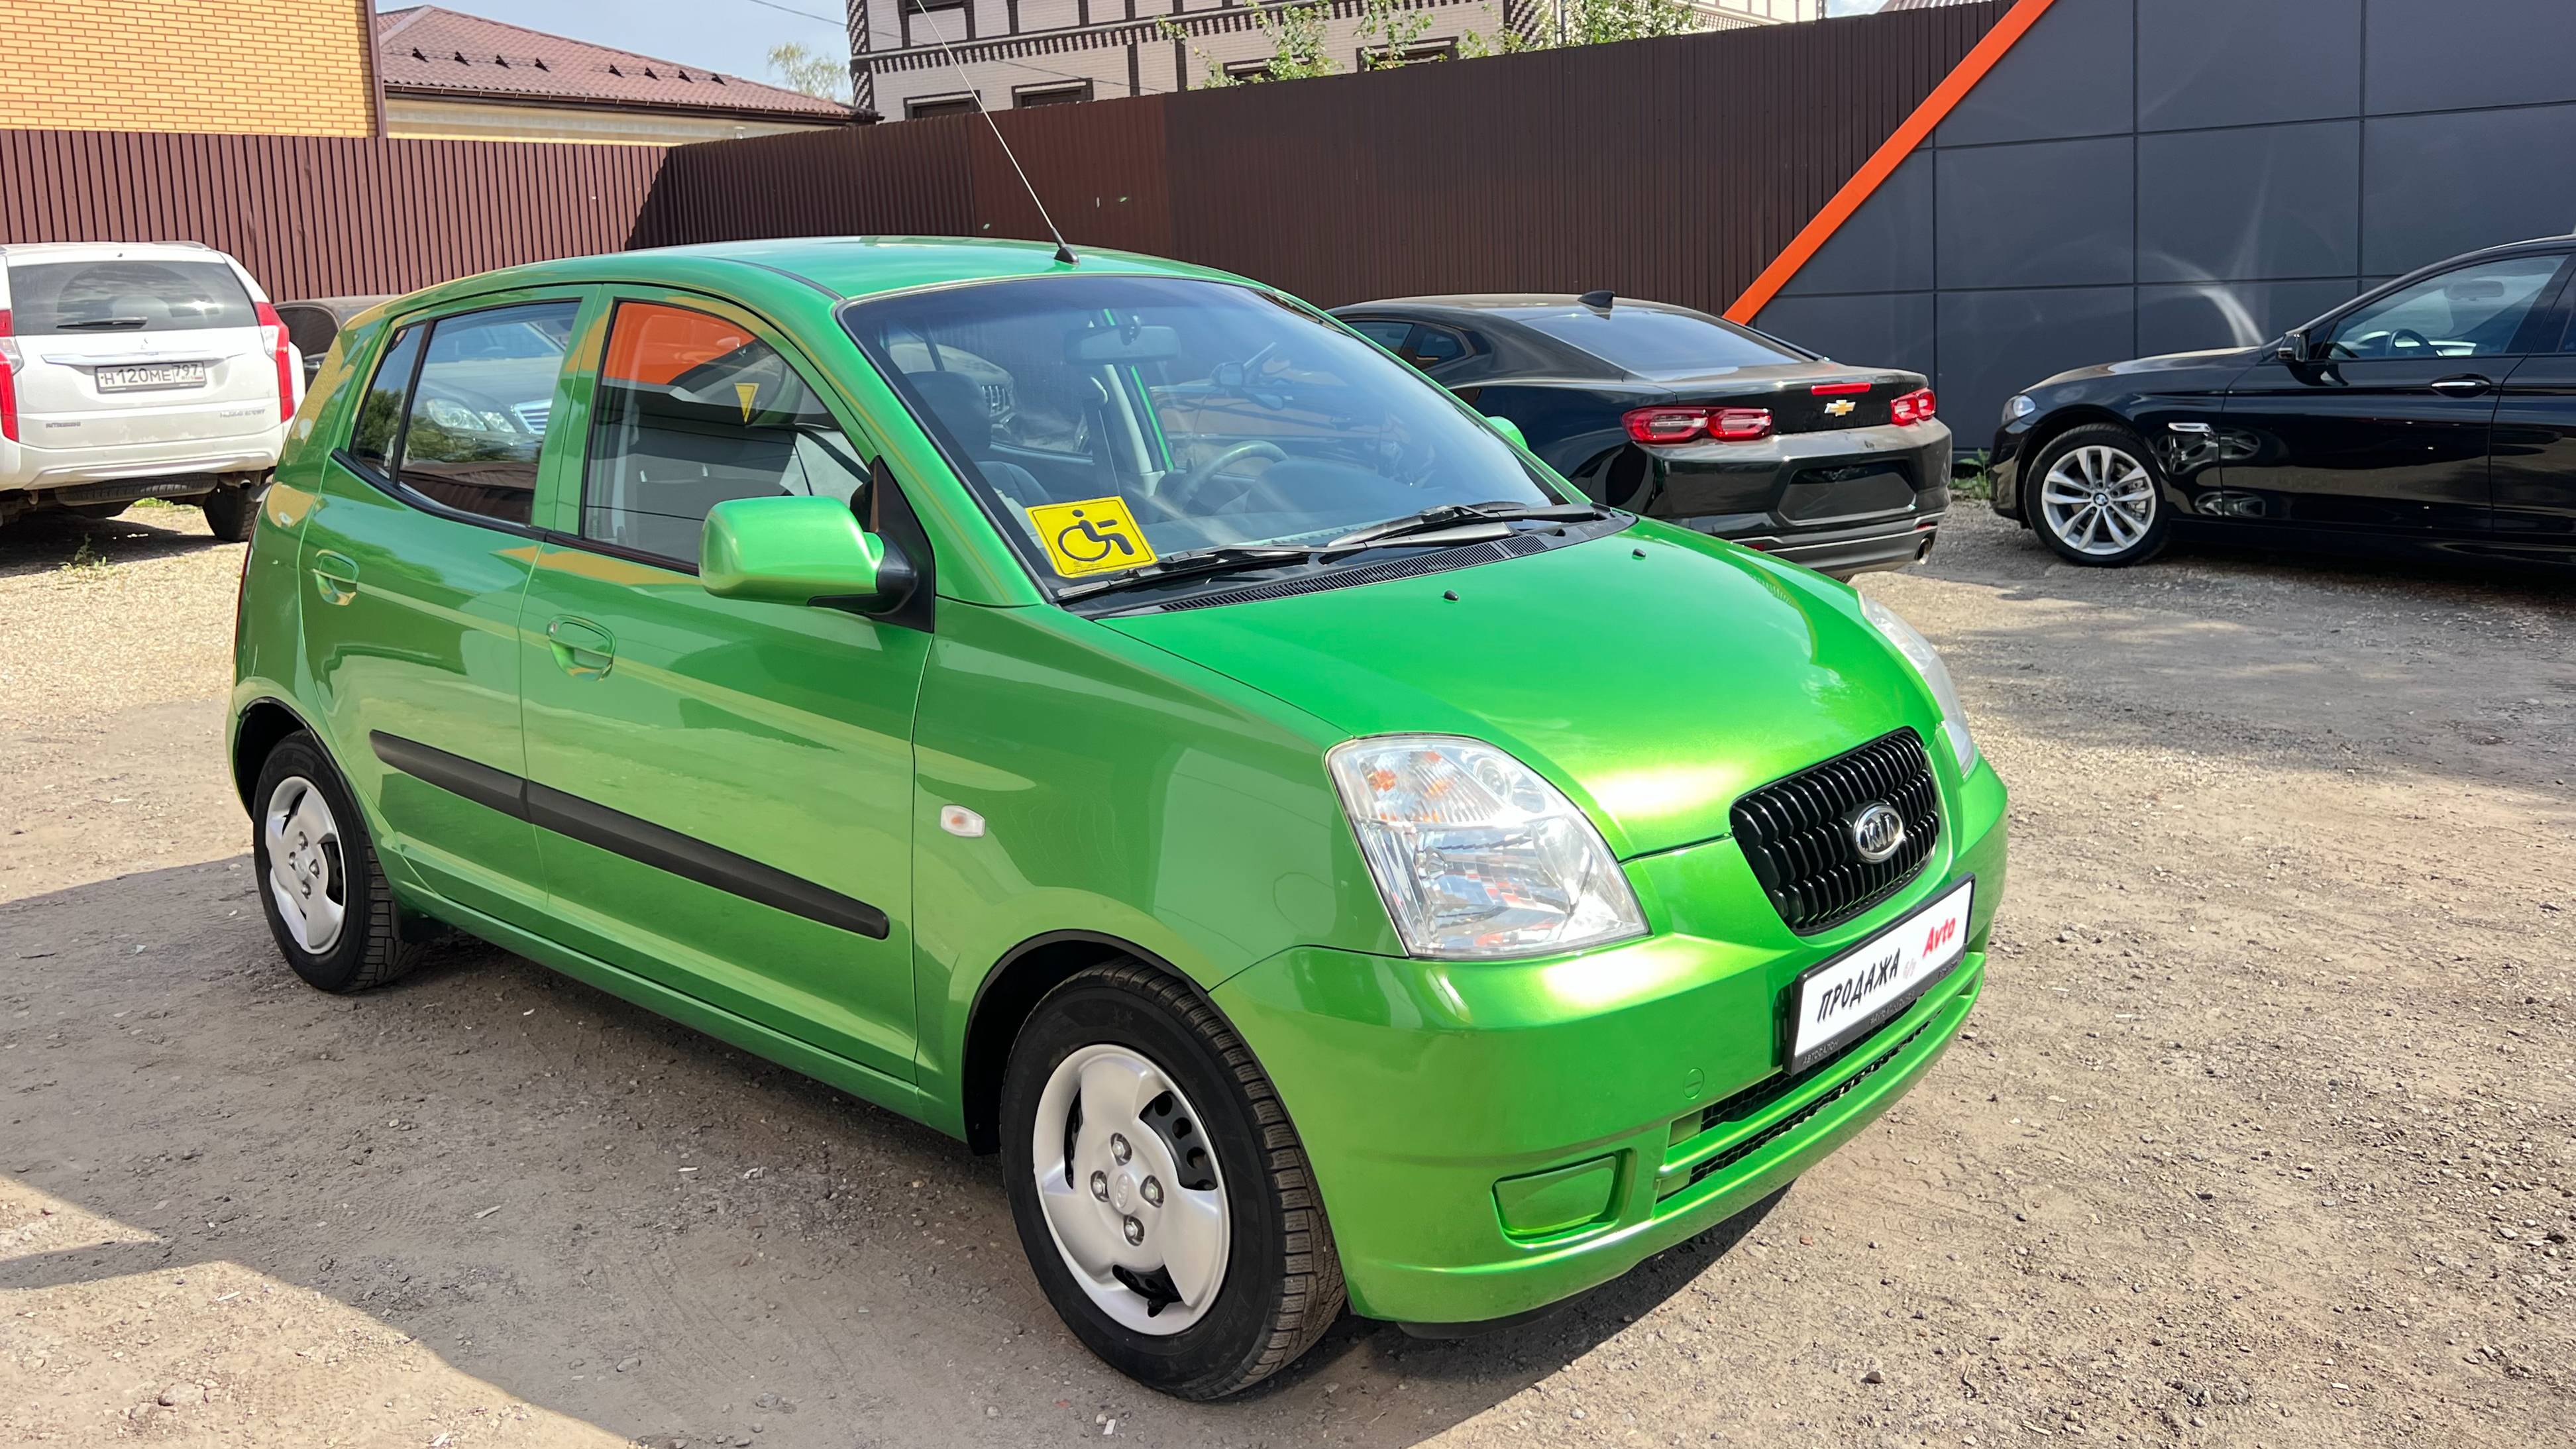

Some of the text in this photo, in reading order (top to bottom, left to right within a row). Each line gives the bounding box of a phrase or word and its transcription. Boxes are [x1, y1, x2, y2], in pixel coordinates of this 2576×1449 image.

[104, 364, 198, 385] Н120МЕ 797
[1817, 947, 1900, 1024] ПРОДАЖА
[1922, 918, 1956, 958] Avto
